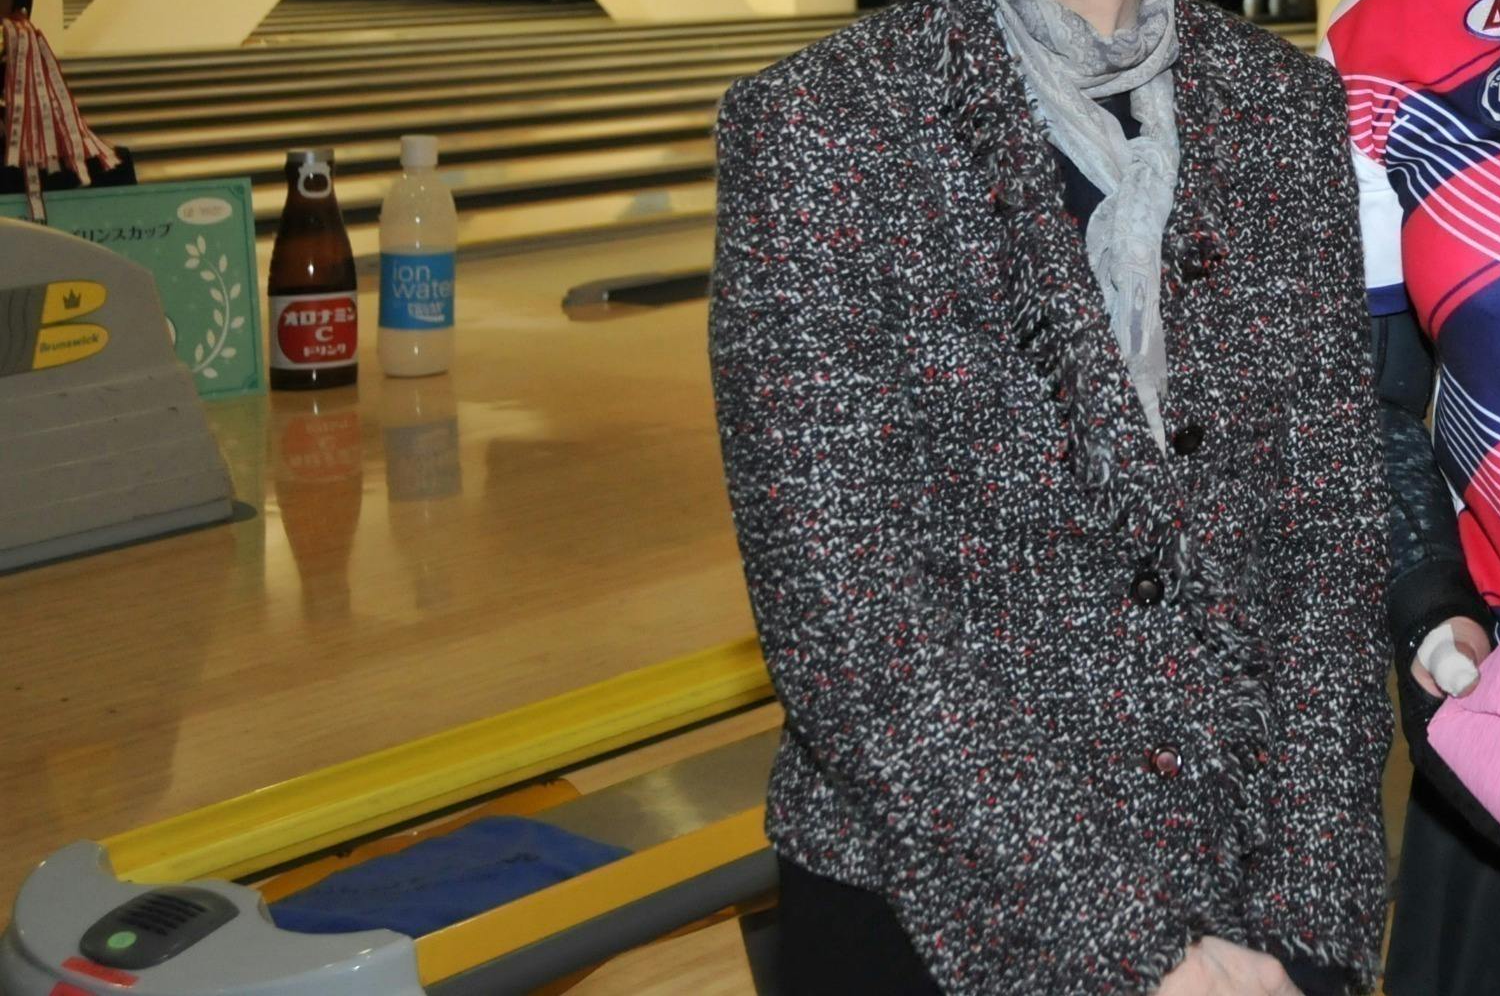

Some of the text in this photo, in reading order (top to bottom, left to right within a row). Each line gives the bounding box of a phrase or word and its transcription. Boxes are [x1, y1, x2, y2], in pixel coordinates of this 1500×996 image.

[392, 259, 431, 283] ion
[393, 279, 454, 300] wate
[283, 306, 356, 327] オロナミン
[39, 331, 101, 354] Brunswick
[314, 326, 334, 342] C
